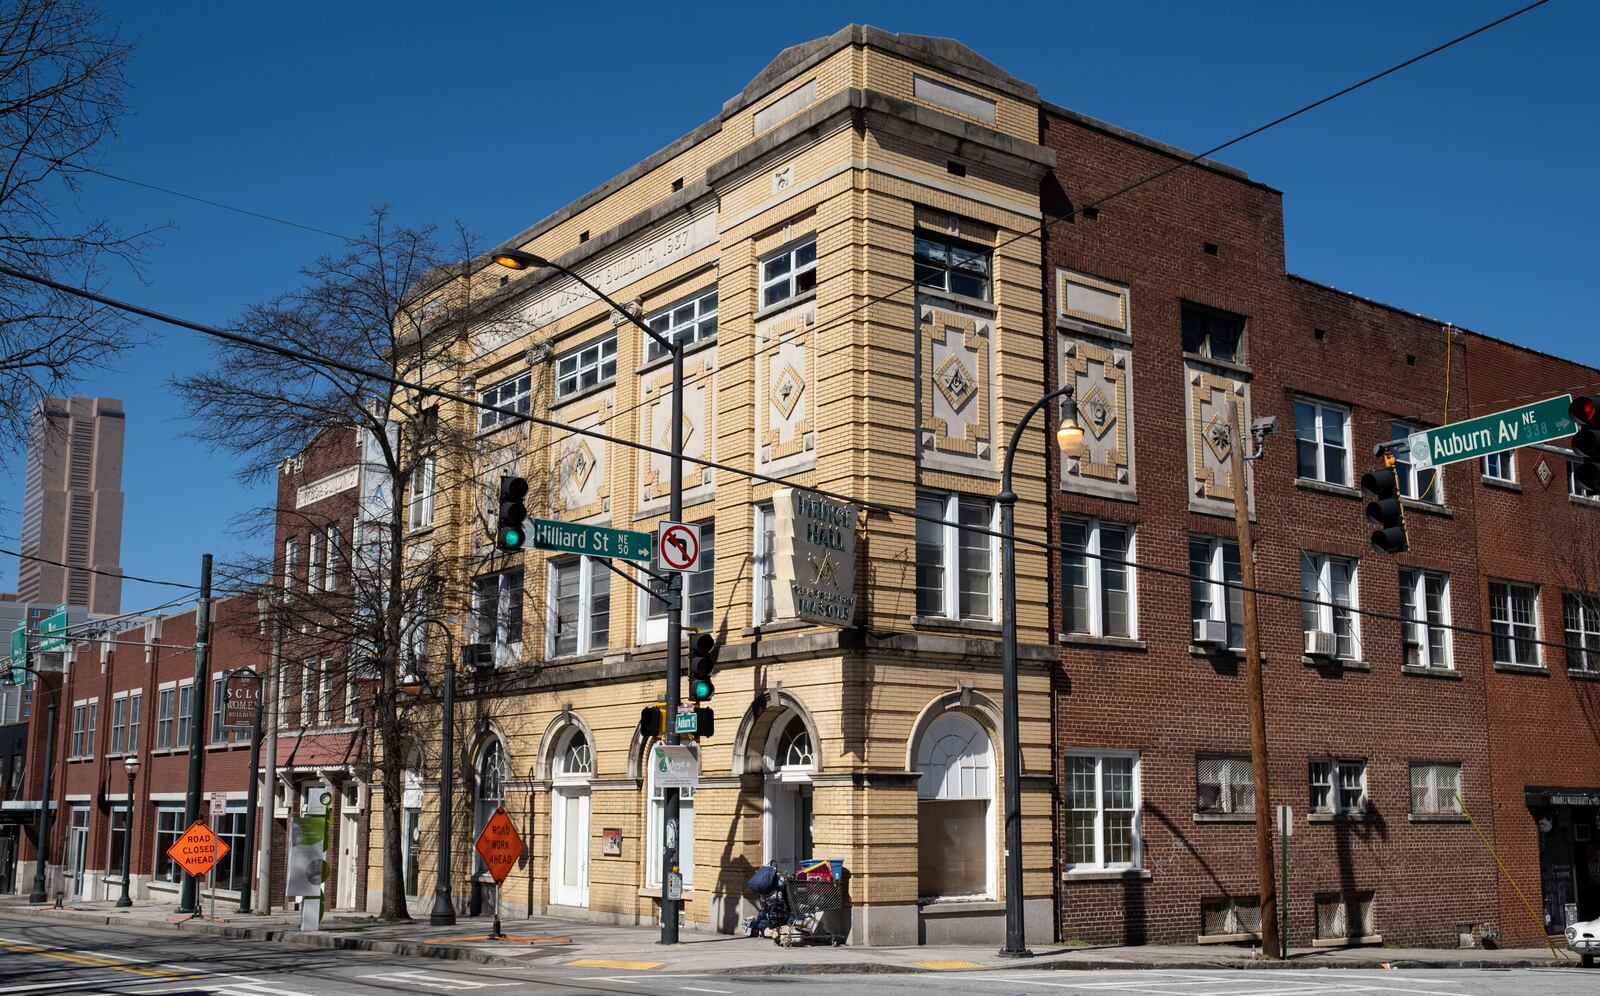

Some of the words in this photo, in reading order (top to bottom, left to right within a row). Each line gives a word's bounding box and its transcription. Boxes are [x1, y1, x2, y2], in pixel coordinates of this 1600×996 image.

[1434, 428, 1491, 459] Auburn
[1498, 419, 1519, 444] Av
[1521, 411, 1536, 426] NE
[1525, 423, 1548, 438] 338
[799, 495, 852, 529] PRINCE
[537, 524, 586, 549] Hilliard
[593, 531, 609, 552] St
[618, 534, 629, 545] NE
[807, 522, 846, 552] HALL
[618, 544, 629, 555] 50
[799, 599, 850, 620] MASONS
[492, 825, 511, 835] ROAD
[187, 835, 211, 843] ROAD
[492, 840, 509, 849] WORK
[182, 846, 215, 854] CLOSED
[185, 856, 214, 865] AHEAD
[489, 854, 512, 864] AHEAD
